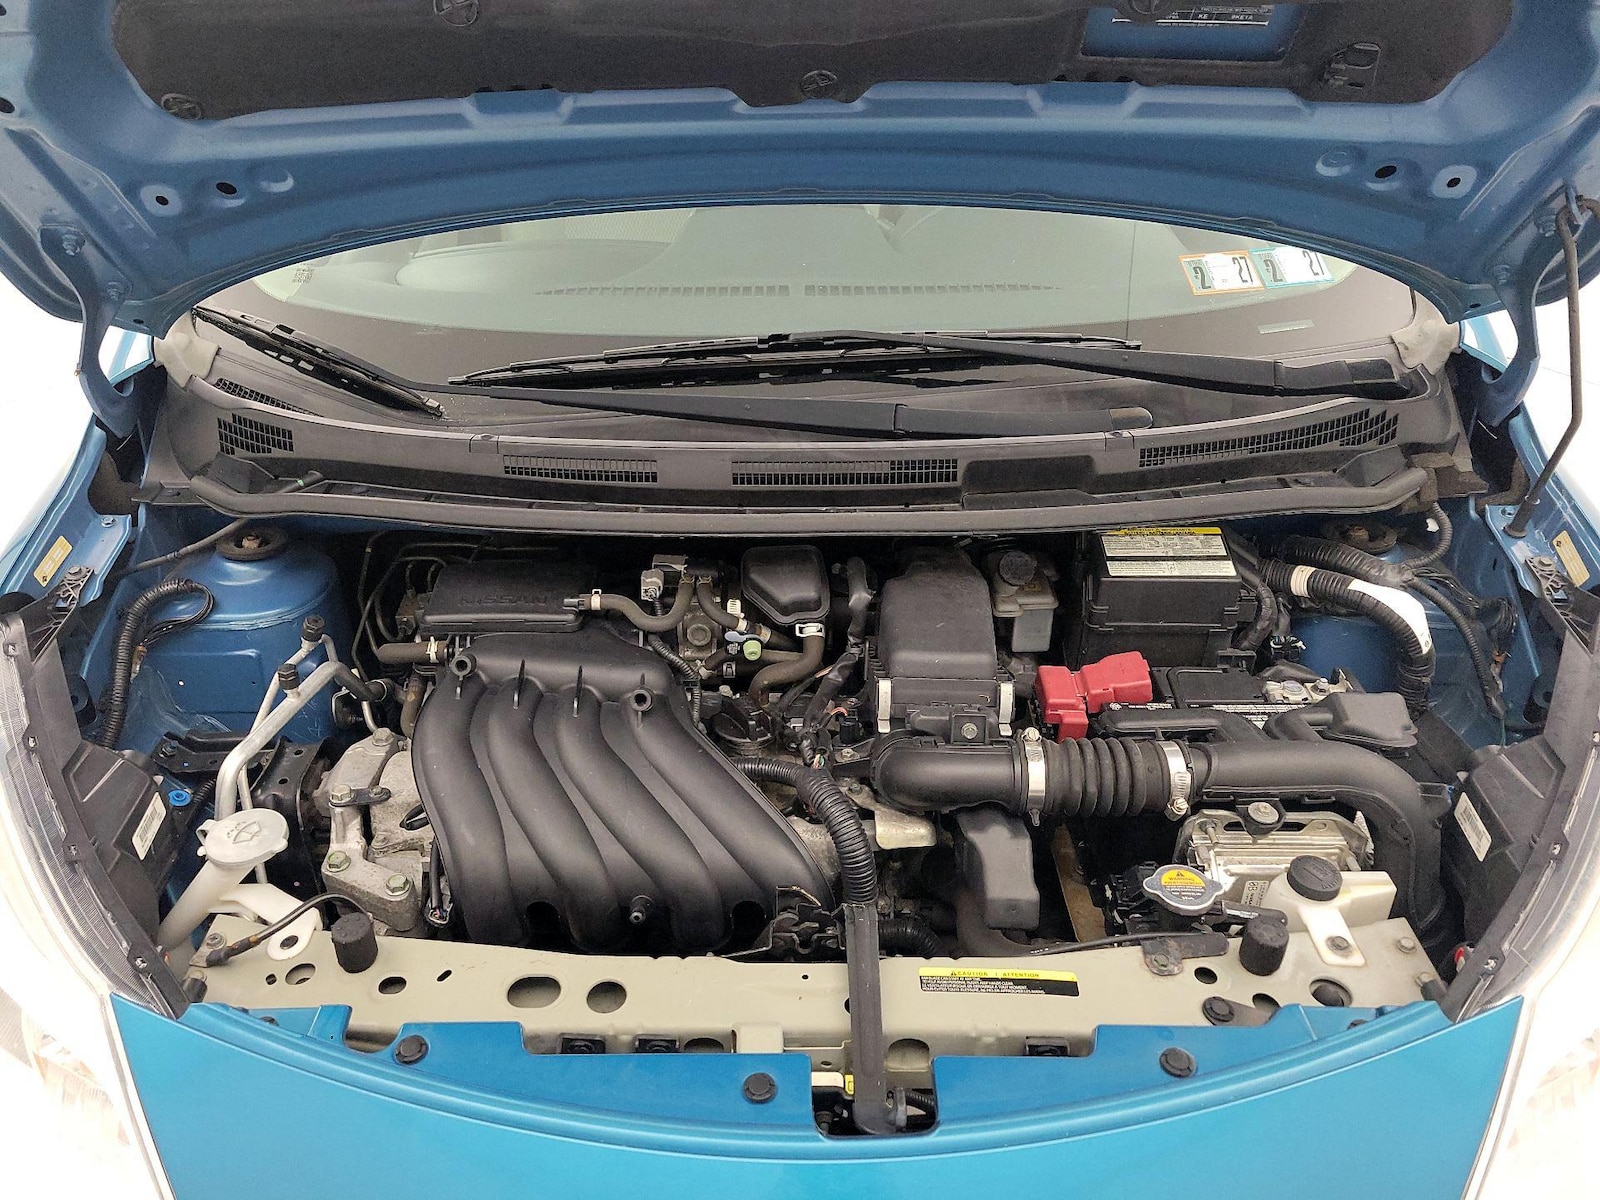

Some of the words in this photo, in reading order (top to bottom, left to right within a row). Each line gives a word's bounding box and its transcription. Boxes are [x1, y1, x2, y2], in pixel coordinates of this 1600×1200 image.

[1193, 266, 1211, 289] 2
[1232, 256, 1253, 283] 27
[1263, 259, 1283, 282] 2
